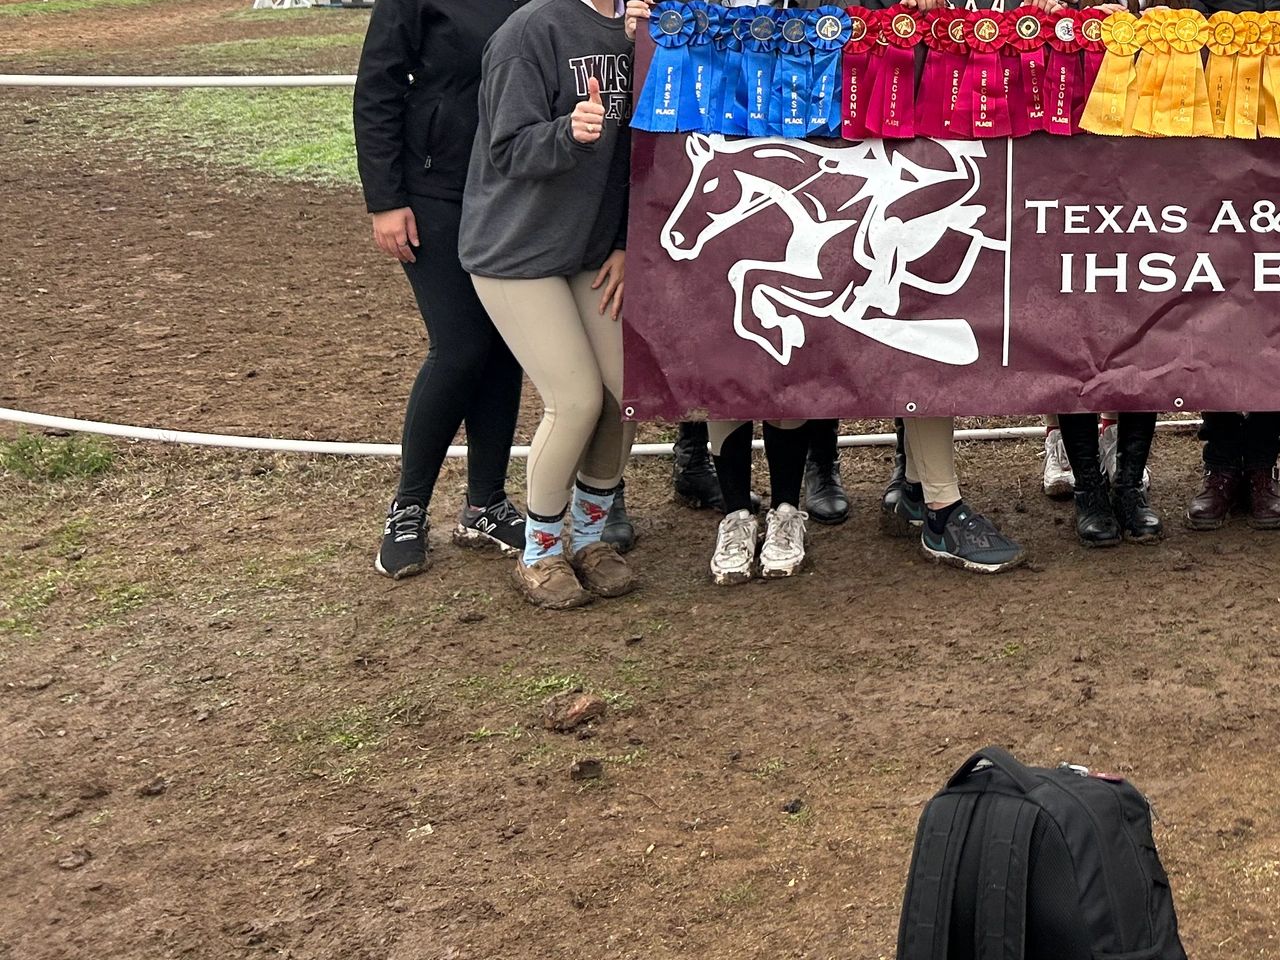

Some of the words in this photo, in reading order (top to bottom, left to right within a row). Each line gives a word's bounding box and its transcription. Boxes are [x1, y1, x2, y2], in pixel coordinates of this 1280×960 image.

[663, 66, 674, 108] FIRST
[695, 65, 704, 102] FIRS
[890, 67, 900, 118] SECOND
[1029, 60, 1040, 110] SECOND
[1057, 67, 1066, 116] SECOND
[655, 108, 676, 116] PLACE
[1030, 110, 1044, 118] PLAC
[1025, 199, 1188, 234] TEXAS
[1060, 252, 1226, 293] IHSA
